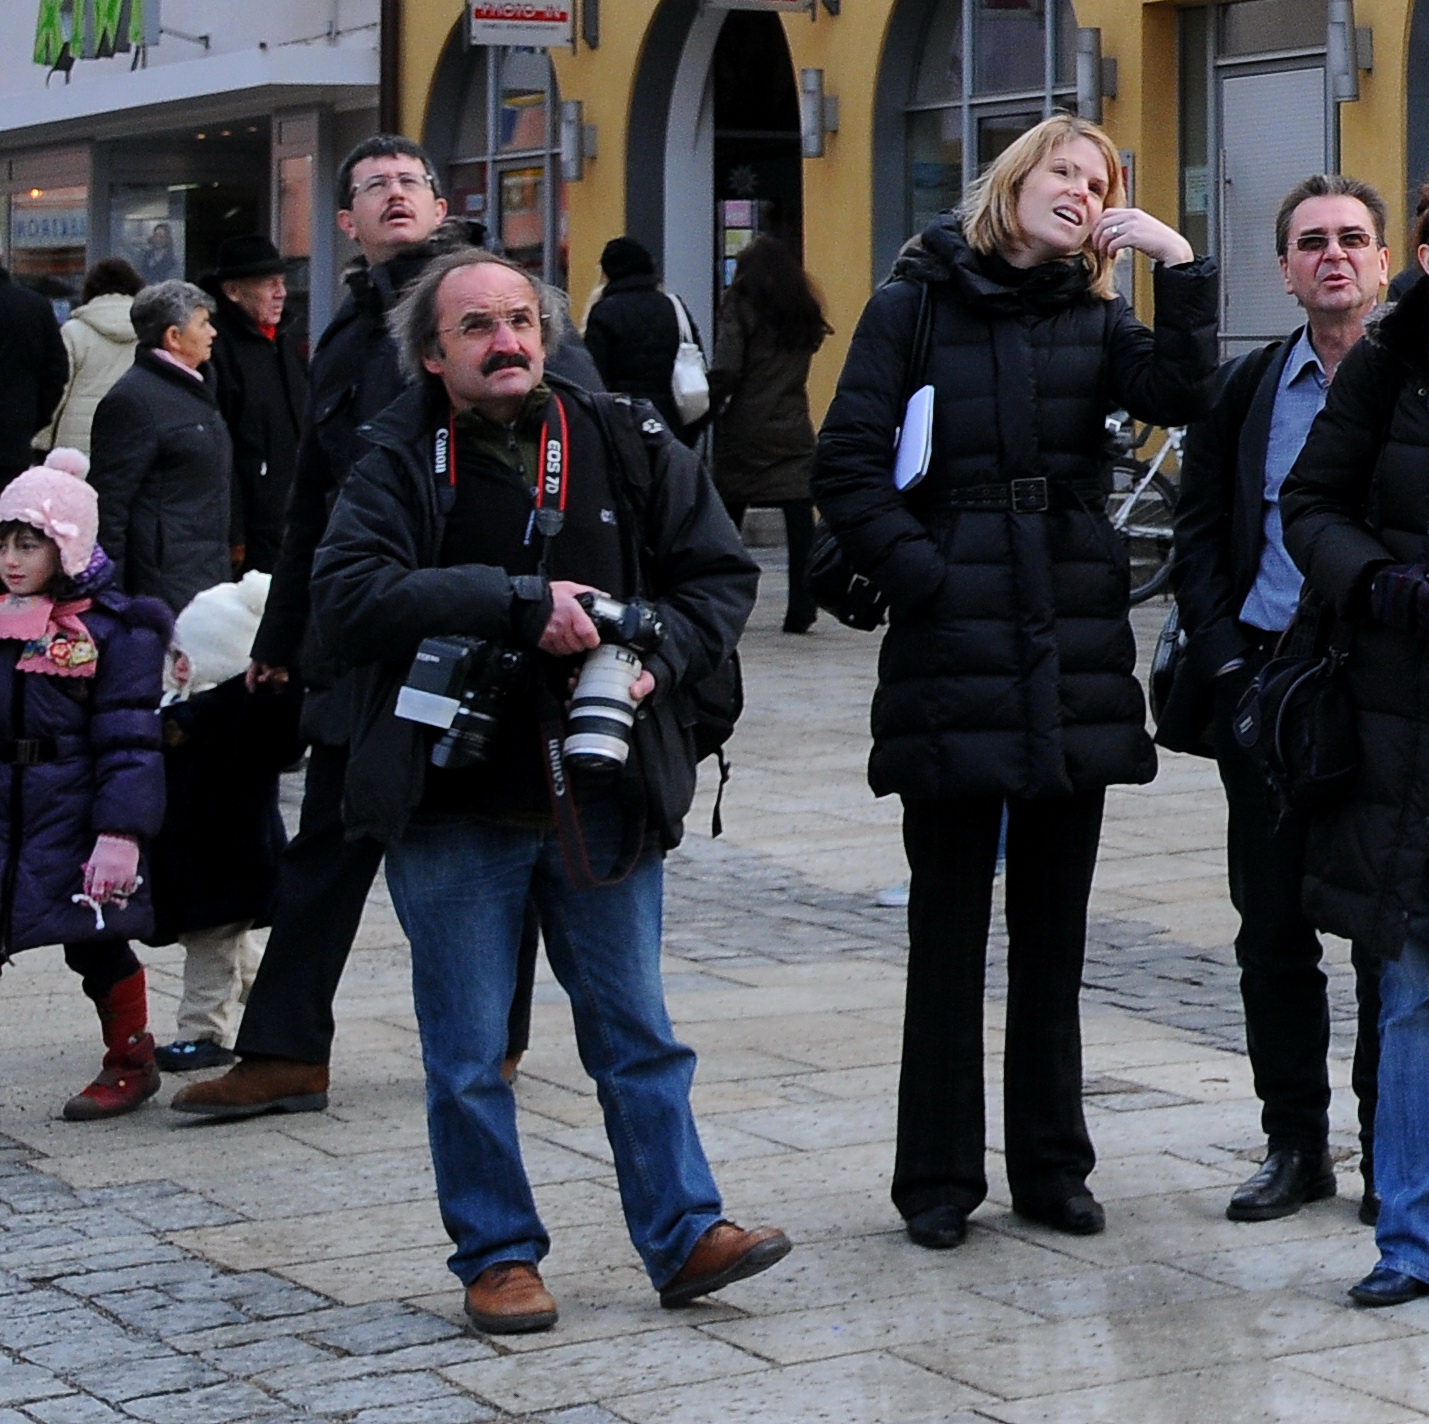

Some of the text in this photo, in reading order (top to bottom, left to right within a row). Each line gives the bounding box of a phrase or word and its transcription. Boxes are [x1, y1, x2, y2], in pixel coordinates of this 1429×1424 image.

[434, 428, 449, 474] Canon
[545, 439, 562, 495] EOS 7D
[548, 738, 566, 797] Canon
